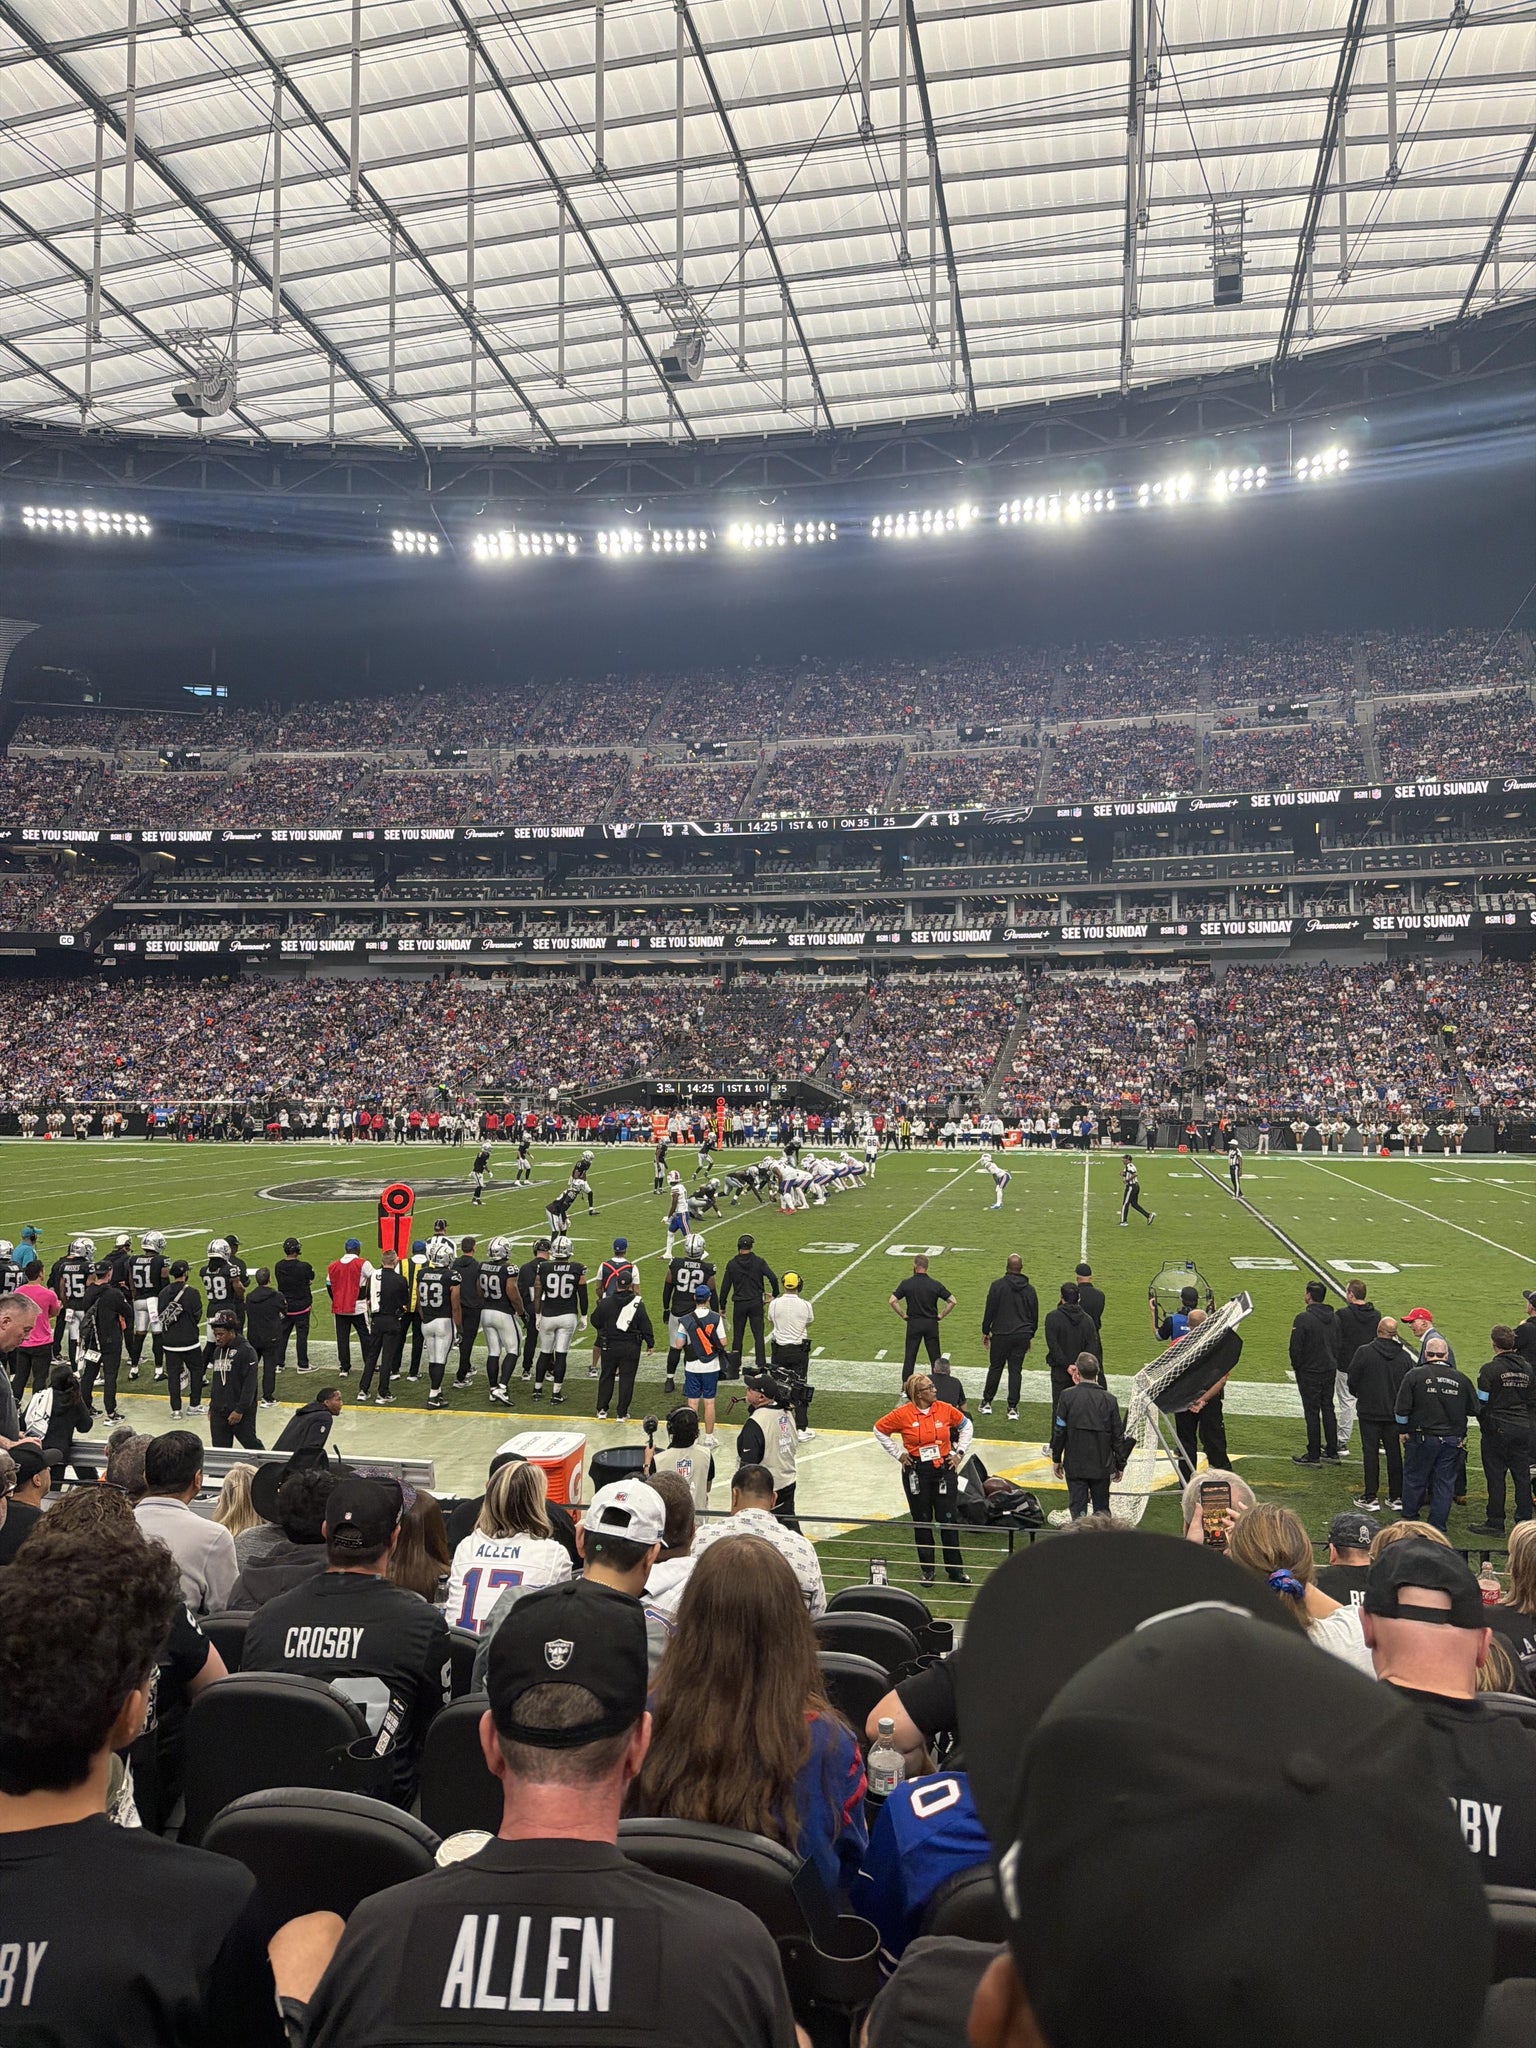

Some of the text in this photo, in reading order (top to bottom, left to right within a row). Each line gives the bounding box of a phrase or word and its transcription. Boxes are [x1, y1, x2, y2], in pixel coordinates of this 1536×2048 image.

[1395, 785, 1415, 798] SEE
[1419, 784, 1441, 797] YOU
[1444, 781, 1489, 795] SUNDAY
[1251, 795, 1271, 807] SEE
[1274, 793, 1294, 805] YOU
[1297, 790, 1341, 804] SUNDAY
[1094, 803, 1112, 816] SEE
[1114, 802, 1134, 815] YOU
[1137, 800, 1177, 814] SUNDAY
[789, 820, 828, 830] 1ST & 10
[841, 818, 869, 828] ON 35
[883, 818, 895, 826] 25
[948, 813, 959, 825] 13
[515, 826, 585, 838] SEE YOU SUNDAY
[662, 824, 673, 836] 13
[714, 823, 721, 833] 3
[748, 821, 777, 832] 14:25
[23, 829, 39, 840] SEE
[42, 830, 60, 840] YOU
[63, 830, 99, 841] SUNDAY
[142, 830, 157, 841] SEE
[160, 830, 176, 841] YOU
[178, 830, 212, 841] SUNDAY
[272, 830, 287, 841] SEE
[289, 829, 306, 840] YOU
[308, 829, 342, 840] SUNDAY
[385, 829, 400, 840] SEE
[402, 829, 419, 840] YOU
[421, 828, 454, 839] SUNDAY
[1201, 923, 1220, 935] SEE
[1223, 922, 1245, 934] YOU
[1248, 920, 1292, 933] SUNDAY
[1373, 914, 1470, 929] SEE YOU SUNDAY
[911, 931, 929, 943] SEE
[931, 930, 951, 942] YOU
[953, 929, 992, 942] SUNDAY
[1062, 927, 1080, 939] SEE
[1083, 927, 1104, 938] YOU
[1106, 925, 1147, 938] SUNDAY
[398, 940, 414, 950] SEE
[417, 940, 434, 950] YOU
[436, 939, 471, 950] SUNDAY
[533, 938, 549, 949] SEE
[552, 938, 569, 949] YOU
[571, 938, 606, 949] SUNDAY
[650, 937, 666, 948] SEE
[669, 937, 687, 947] YOU
[689, 936, 724, 947] SUNDAY
[788, 934, 805, 945] SEE
[808, 934, 825, 945] YOU
[827, 932, 865, 945] SUNDAY
[146, 941, 162, 951] SEE
[165, 941, 182, 951] YOU
[184, 941, 219, 951] SUNDAY
[281, 940, 297, 951] SEE
[300, 941, 317, 951] YOU
[320, 940, 355, 951] SUNDAY
[657, 1083, 663, 1093] 3
[687, 1084, 714, 1093] 14:25
[727, 1084, 765, 1093] 1ST & 10
[867, 1139, 877, 1147] 86
[133, 1265, 154, 1288] 51
[677, 1268, 704, 1293] 92
[203, 1276, 227, 1300] 28
[479, 1274, 502, 1299] 99
[546, 1273, 575, 1299] 96
[418, 1282, 443, 1308] 93
[475, 1543, 520, 1559] ALLEN
[284, 1626, 365, 1659] CROSBY
[1448, 1797, 1502, 1857] BY
[440, 1914, 614, 2012] ALLEN
